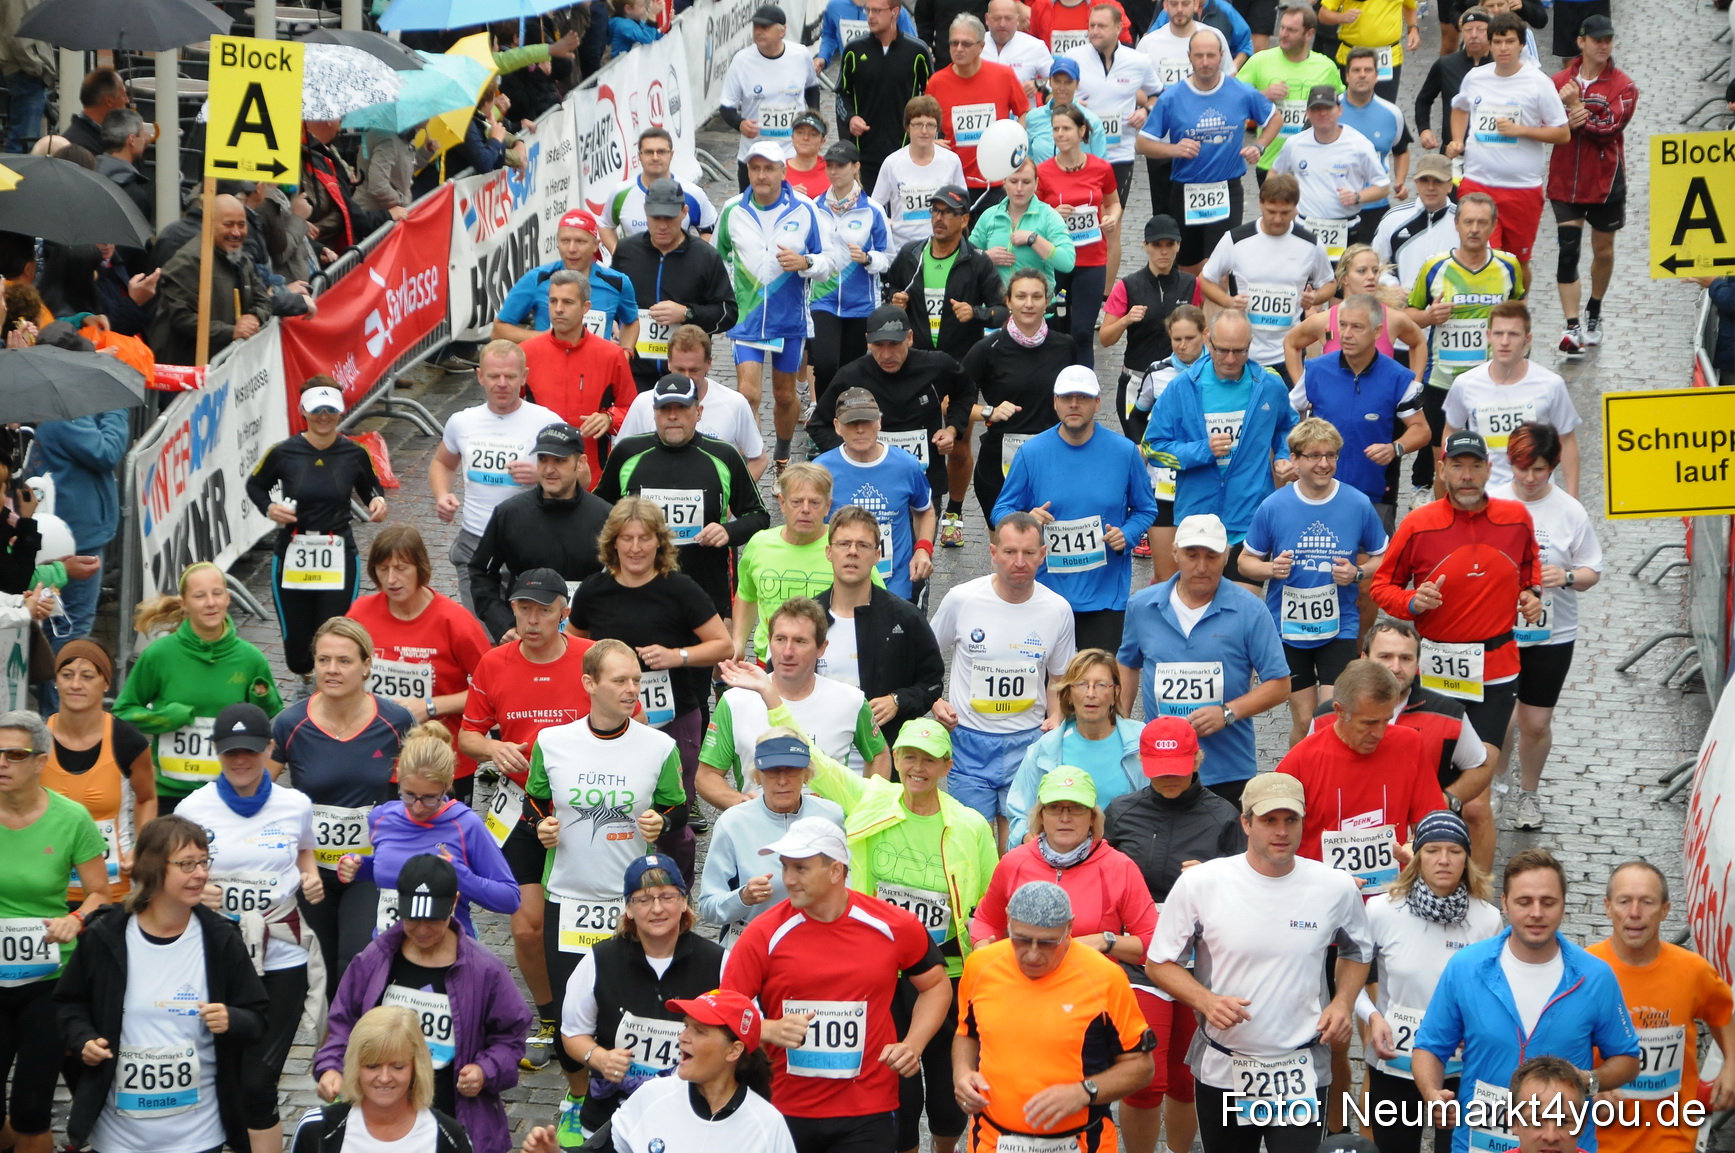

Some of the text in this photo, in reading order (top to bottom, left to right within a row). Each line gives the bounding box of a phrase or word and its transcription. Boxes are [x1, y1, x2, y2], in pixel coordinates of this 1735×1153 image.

[220, 42, 292, 72] Block
[227, 82, 279, 150] A
[762, 112, 795, 128] 2187
[956, 114, 992, 130] 2877
[1190, 192, 1225, 208] 2362
[1670, 176, 1727, 246] A
[1251, 295, 1292, 314] 2065
[1453, 294, 1504, 305] BOCK
[648, 322, 670, 340] 92
[1440, 330, 1482, 348] 3103
[482, 474, 504, 484] Klaus
[1676, 458, 1729, 484] lauf
[1062, 522, 1092, 531] Neumarkt
[1050, 530, 1098, 553] 2141
[296, 549, 332, 568] 310
[1062, 556, 1090, 566] Robert
[1287, 598, 1334, 620] 2169
[973, 664, 994, 673] PARTL
[1179, 668, 1212, 676] Neumarkt
[1432, 655, 1470, 679] 315
[372, 674, 425, 699] 2559
[984, 675, 1025, 698] 160
[1162, 677, 1216, 700] 2251
[1444, 680, 1460, 690] Rolf
[506, 709, 564, 720] SCHULTHEISS
[995, 702, 1011, 712] Ulli
[184, 762, 200, 772] Eva
[578, 770, 626, 787] FÜRTH
[568, 788, 635, 814] 2013
[330, 813, 364, 821] Neumarkt
[1352, 816, 1372, 828] DEHN
[316, 822, 362, 846] 332
[606, 830, 635, 842] OBI
[1350, 834, 1384, 843] Neumarkt
[1332, 842, 1392, 871] 2305
[878, 886, 938, 904] PARTL Neumarkt
[576, 904, 620, 930] 238
[386, 991, 448, 1010] PARTL Neumarkt
[814, 1008, 852, 1017] Neumarkt
[1394, 1012, 1418, 1024] PARTL
[118, 1050, 184, 1060] PARTL Neumarkt
[1232, 1058, 1297, 1068] PARTL Neumarkt
[124, 1062, 192, 1090] 2658
[1240, 1068, 1307, 1098] 2203
[138, 1096, 177, 1108] Renate
[1476, 1088, 1498, 1102] PARTL
[998, 1142, 1068, 1153] PARTL Neumarkt
